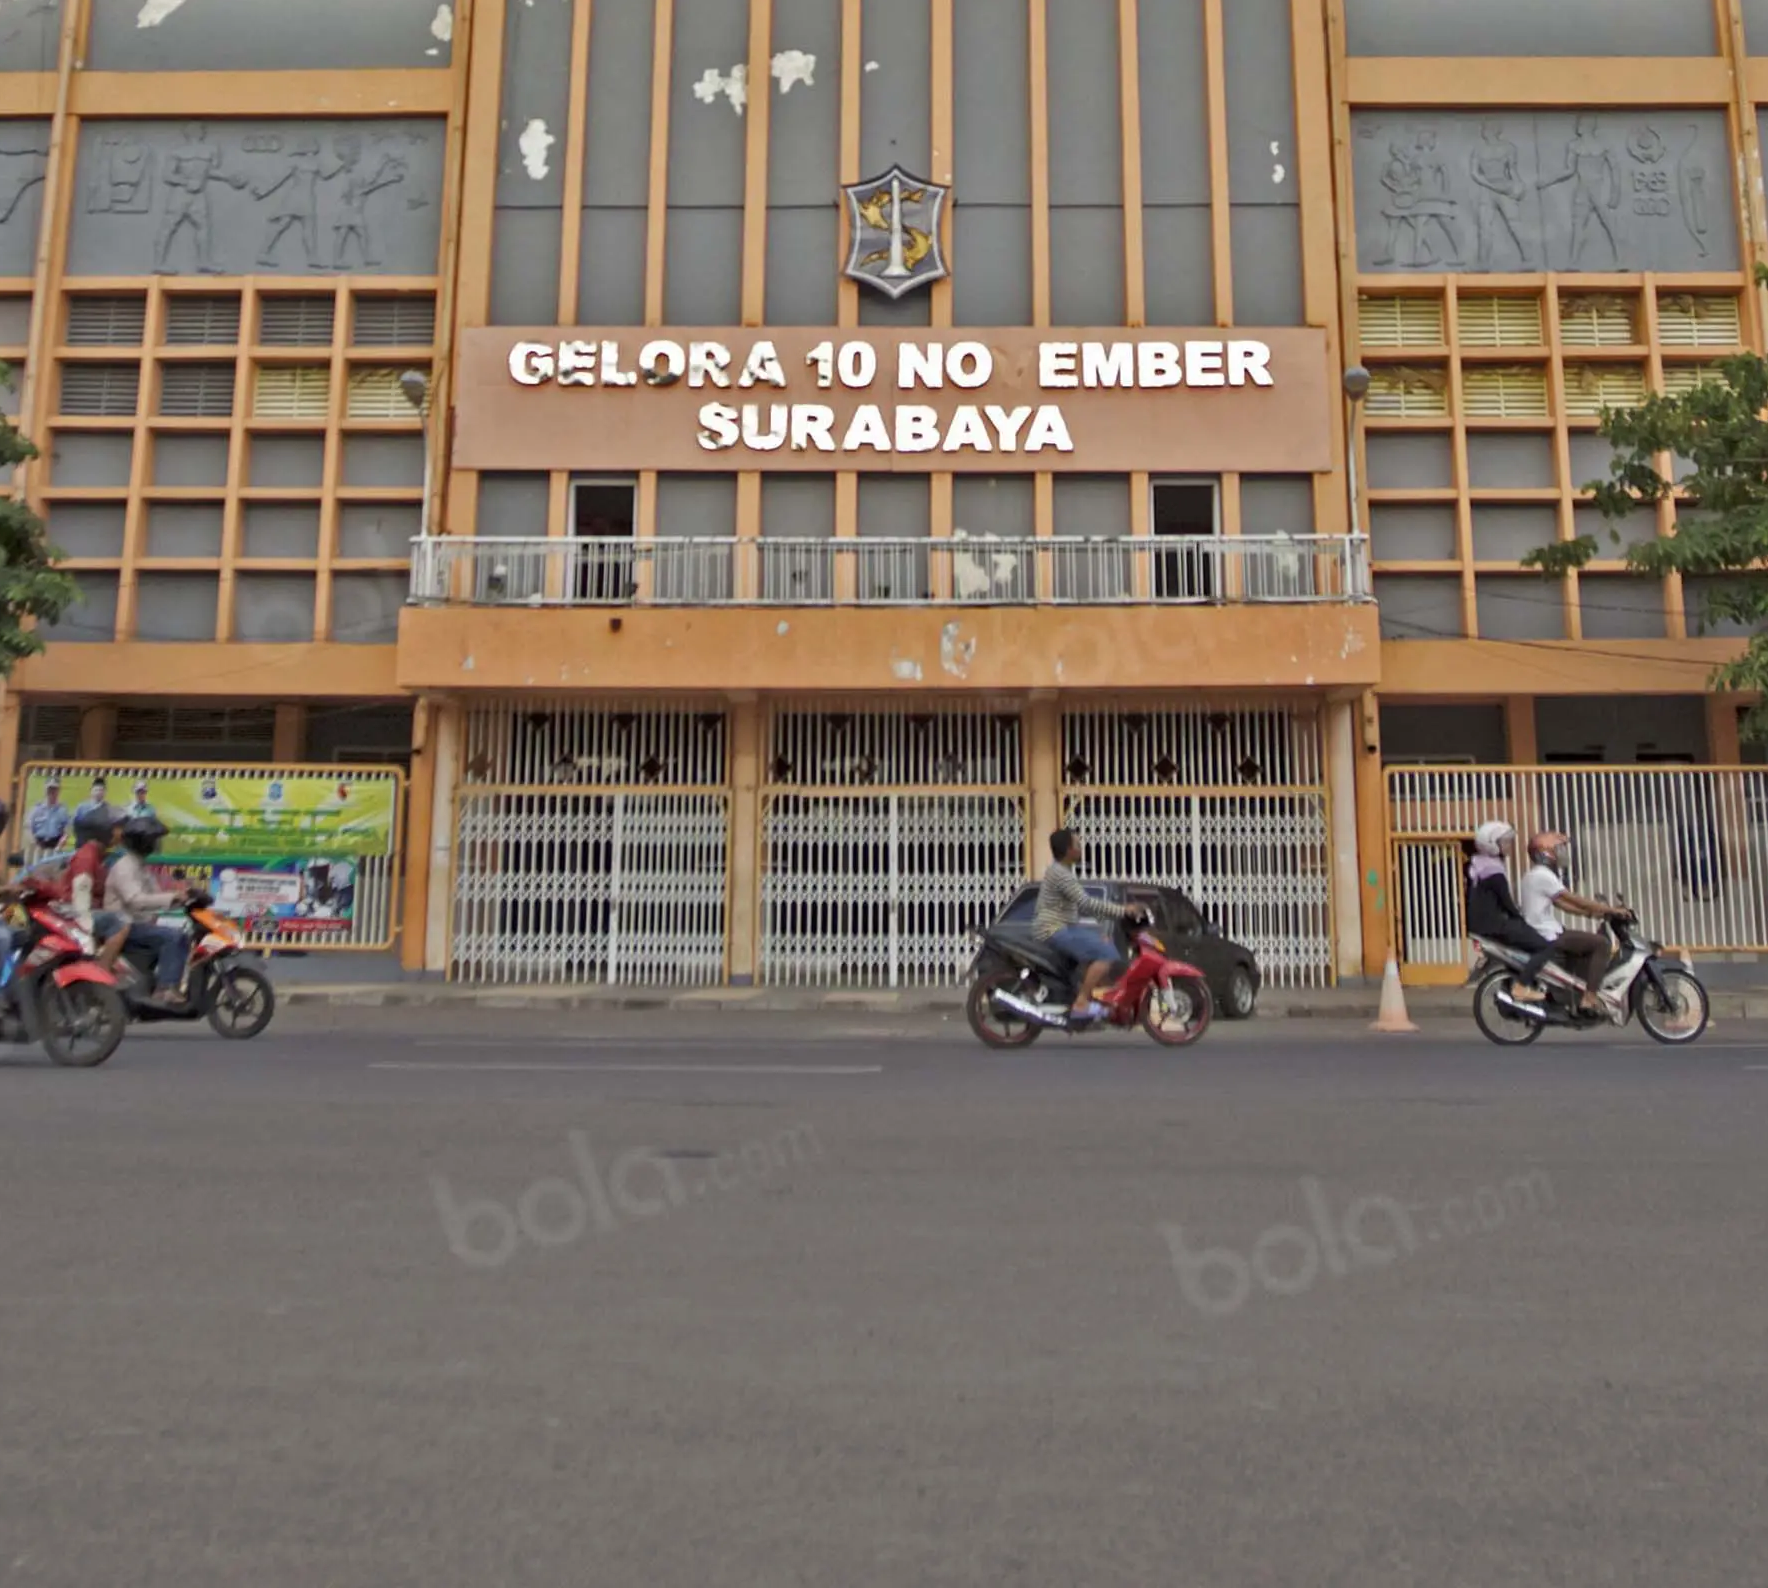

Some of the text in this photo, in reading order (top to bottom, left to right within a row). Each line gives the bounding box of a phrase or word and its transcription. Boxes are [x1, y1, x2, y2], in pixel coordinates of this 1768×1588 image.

[507, 338, 787, 388] GELORA
[805, 339, 876, 388] 10
[696, 402, 1075, 453] SURABAYA
